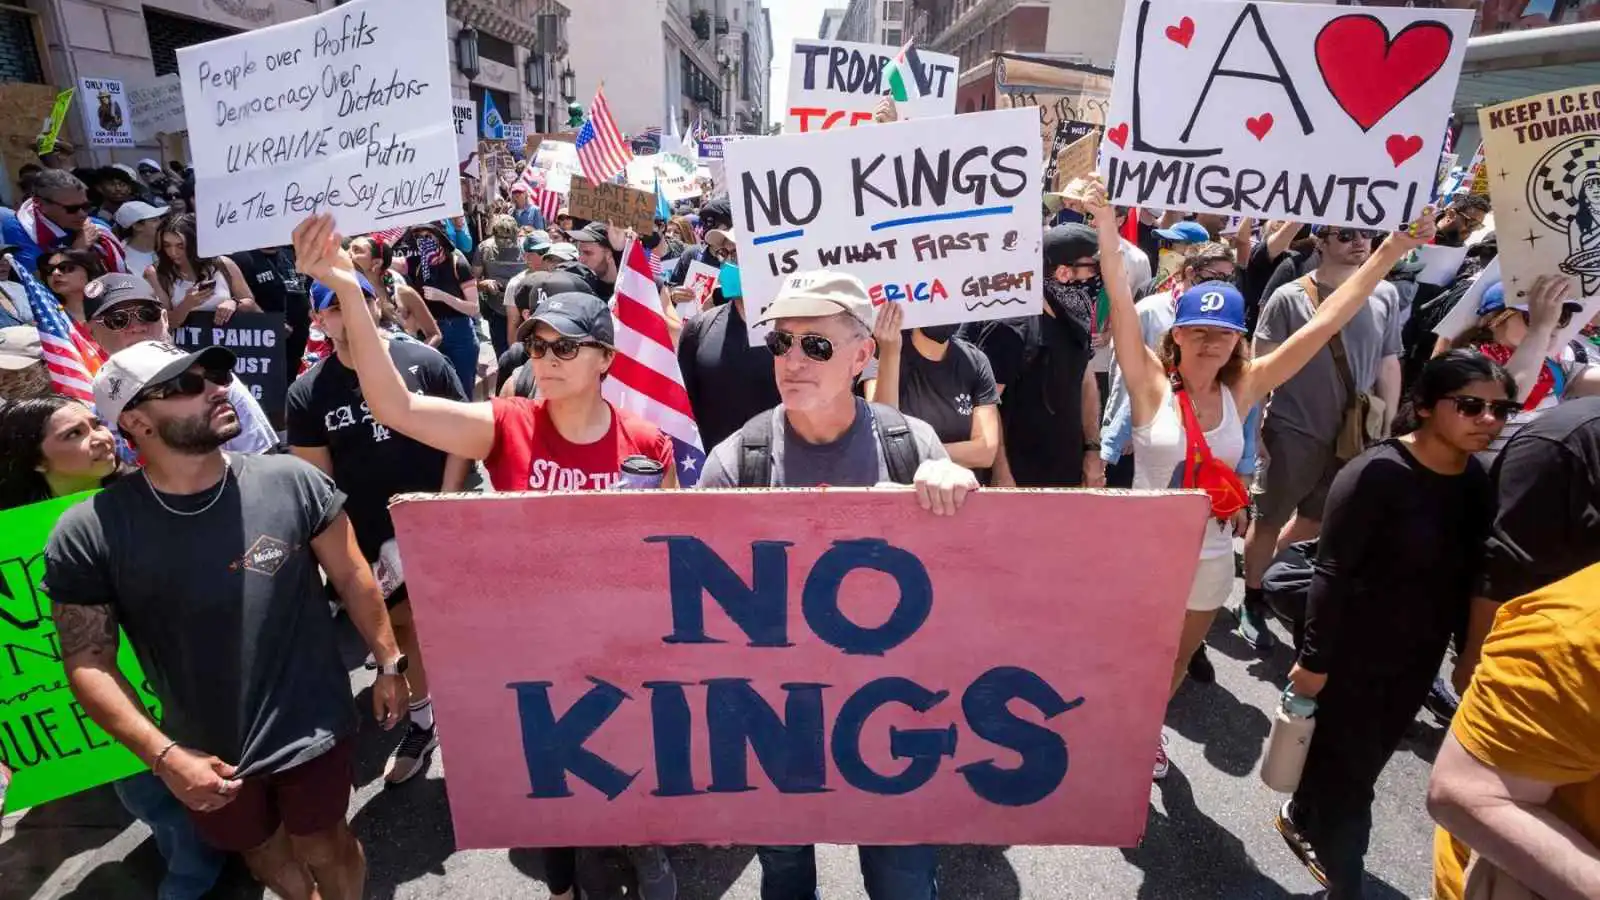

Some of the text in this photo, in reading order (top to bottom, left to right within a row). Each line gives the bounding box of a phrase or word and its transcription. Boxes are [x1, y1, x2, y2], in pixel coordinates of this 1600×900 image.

[199, 11, 378, 92] People over Profits
[795, 44, 890, 96] TROOP
[85, 80, 120, 91] ONLY YOU
[216, 84, 319, 127] Democracy
[322, 64, 362, 98] Over
[338, 69, 430, 118] Dictators
[1132, 0, 1314, 157] LA
[1489, 102, 1542, 130] KEEP
[1514, 112, 1600, 144] TOVAAN
[227, 122, 380, 173] UKRAINE over
[365, 133, 416, 168] Putin
[216, 168, 450, 228] We The People Say ENOUGH
[741, 166, 822, 232] NO
[851, 145, 1028, 217] KINGS
[1107, 156, 1419, 232] IMMIGRANTS!
[768, 232, 989, 276] IS WHAT FIRST
[868, 270, 1034, 309] ERICA GREAT
[1200, 292, 1225, 312] D
[175, 326, 276, 347] N'T PANIC
[234, 357, 272, 374] UST
[529, 458, 619, 490] STOP TH
[643, 535, 933, 656] NO
[505, 665, 1086, 807] KINGS
